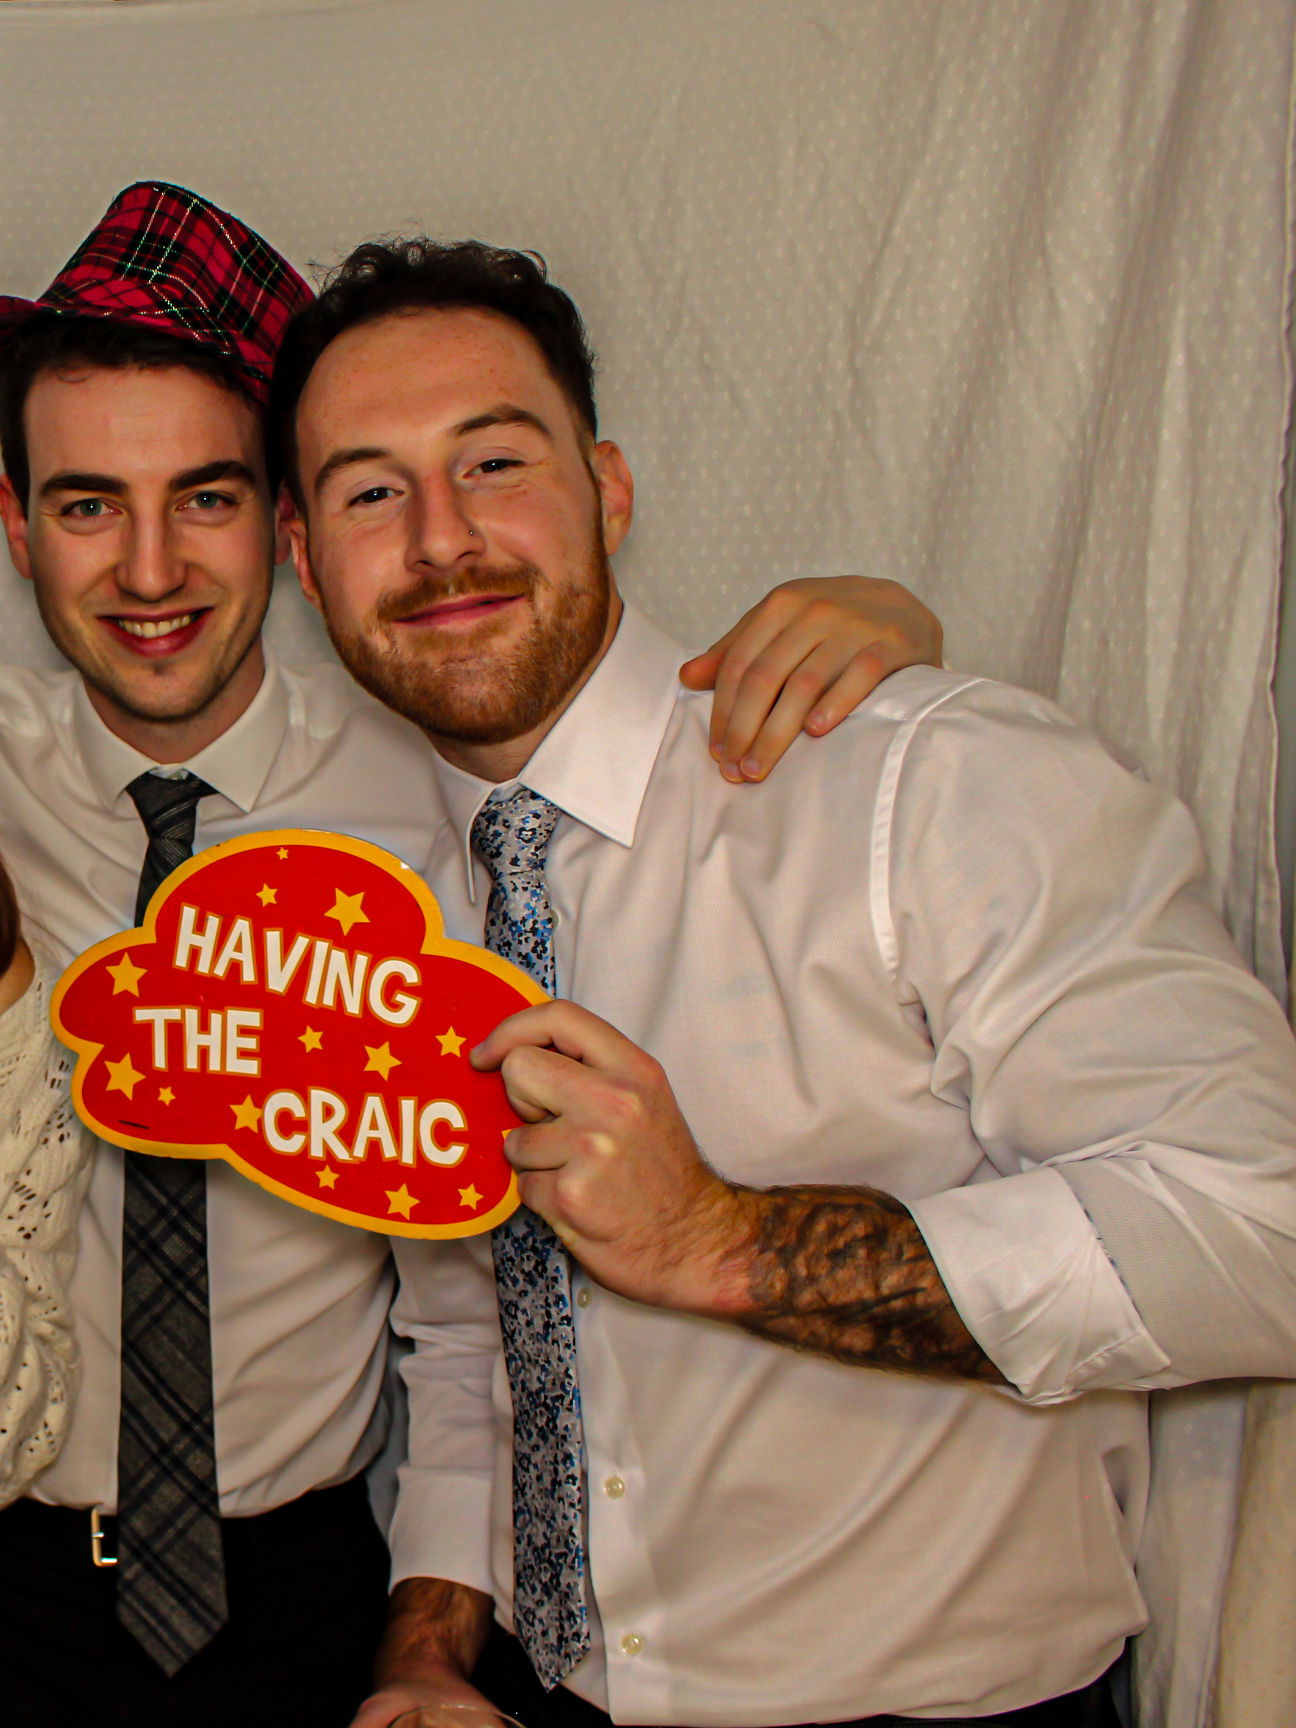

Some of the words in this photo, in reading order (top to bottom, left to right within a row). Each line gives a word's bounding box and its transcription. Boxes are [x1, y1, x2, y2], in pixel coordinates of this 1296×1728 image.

[174, 904, 421, 1026] HAVING
[133, 1007, 262, 1076] THE
[262, 1088, 468, 1167] CRAIC
